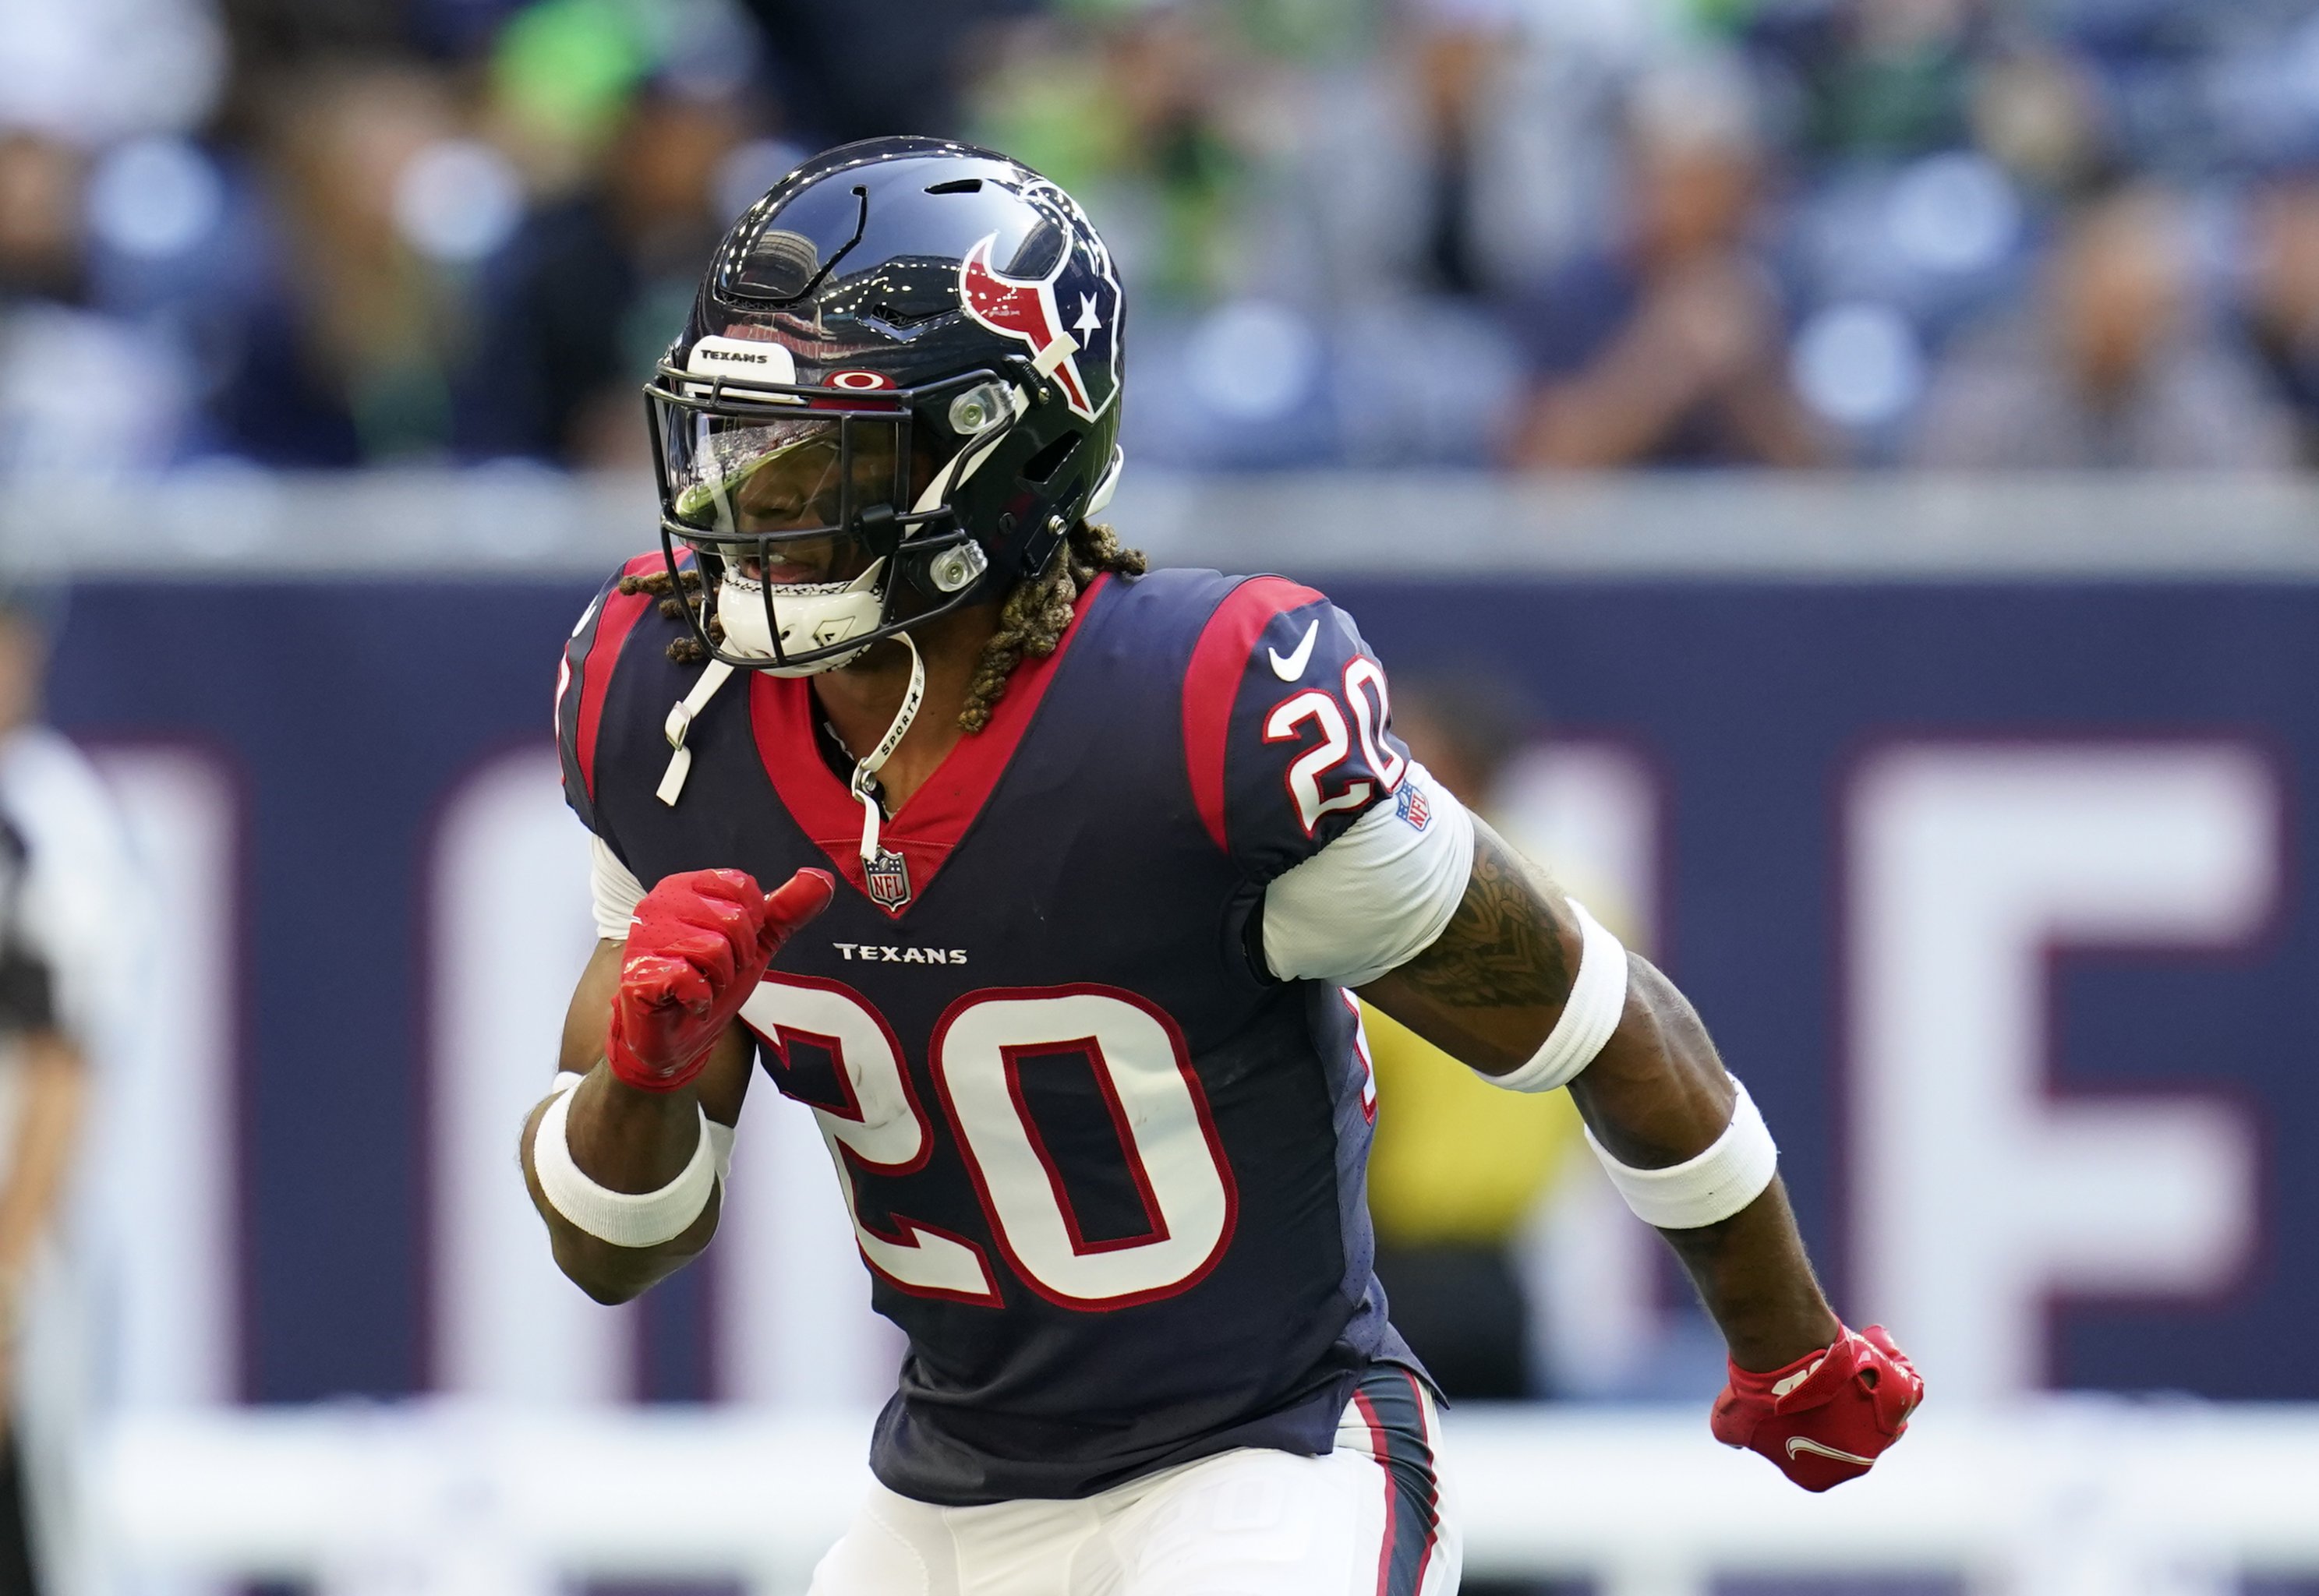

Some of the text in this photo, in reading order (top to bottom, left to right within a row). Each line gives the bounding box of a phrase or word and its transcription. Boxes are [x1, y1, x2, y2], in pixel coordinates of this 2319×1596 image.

[700, 348, 768, 364] TEXANS
[882, 704, 915, 756] SPORT
[1261, 652, 1406, 841] 20
[1409, 794, 1427, 828] NFL
[872, 875, 903, 899] NFL
[833, 942, 967, 964] TEXANS
[738, 971, 1239, 1312] 20
